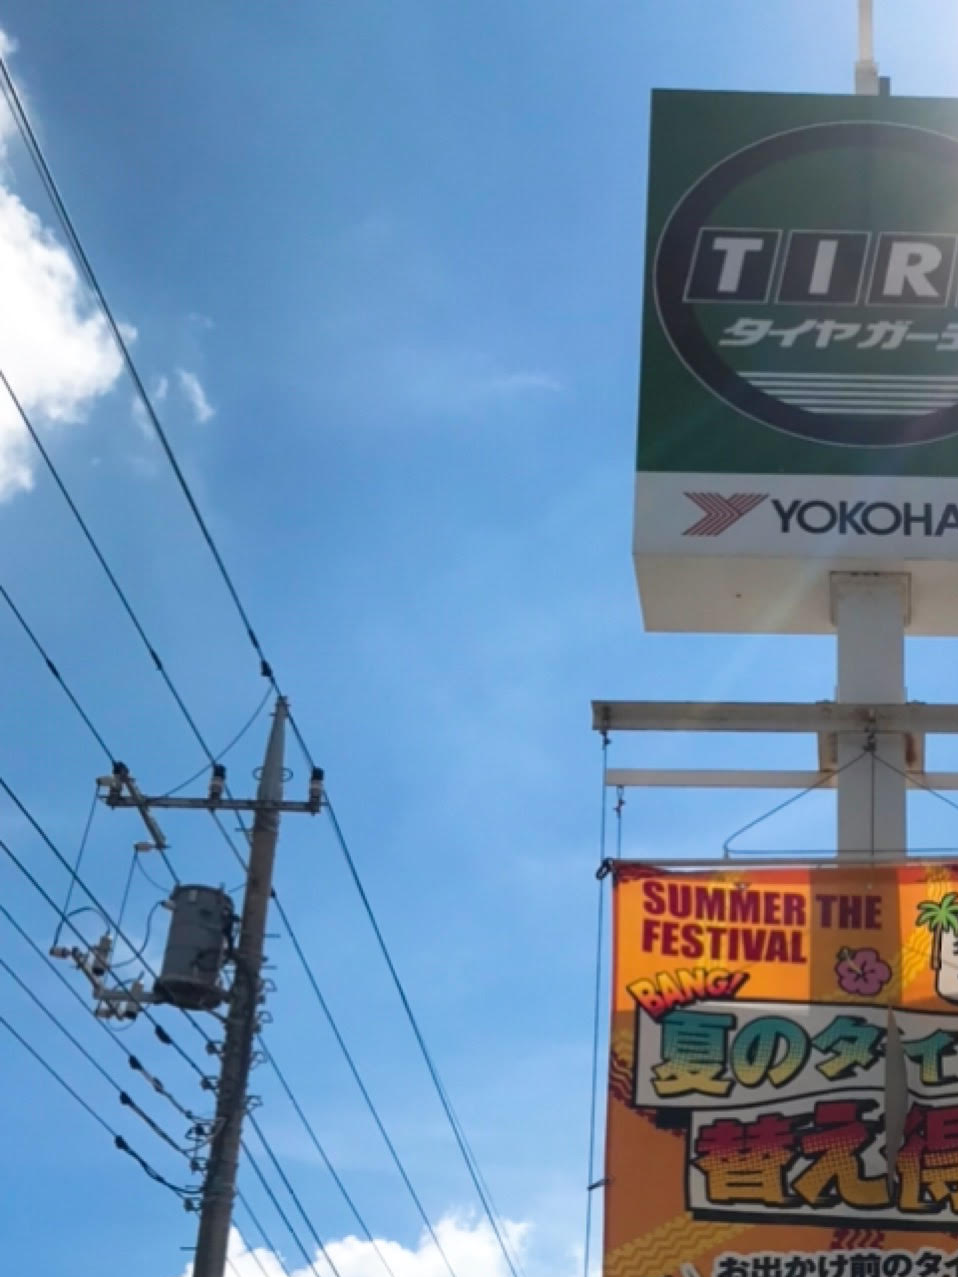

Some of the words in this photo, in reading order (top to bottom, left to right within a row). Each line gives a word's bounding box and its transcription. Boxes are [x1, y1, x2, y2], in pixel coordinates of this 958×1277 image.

[642, 880, 806, 927] SUMMER
[816, 894, 883, 931] THE
[642, 924, 807, 964] FESTIVAL
[627, 967, 750, 1019] BANG!
